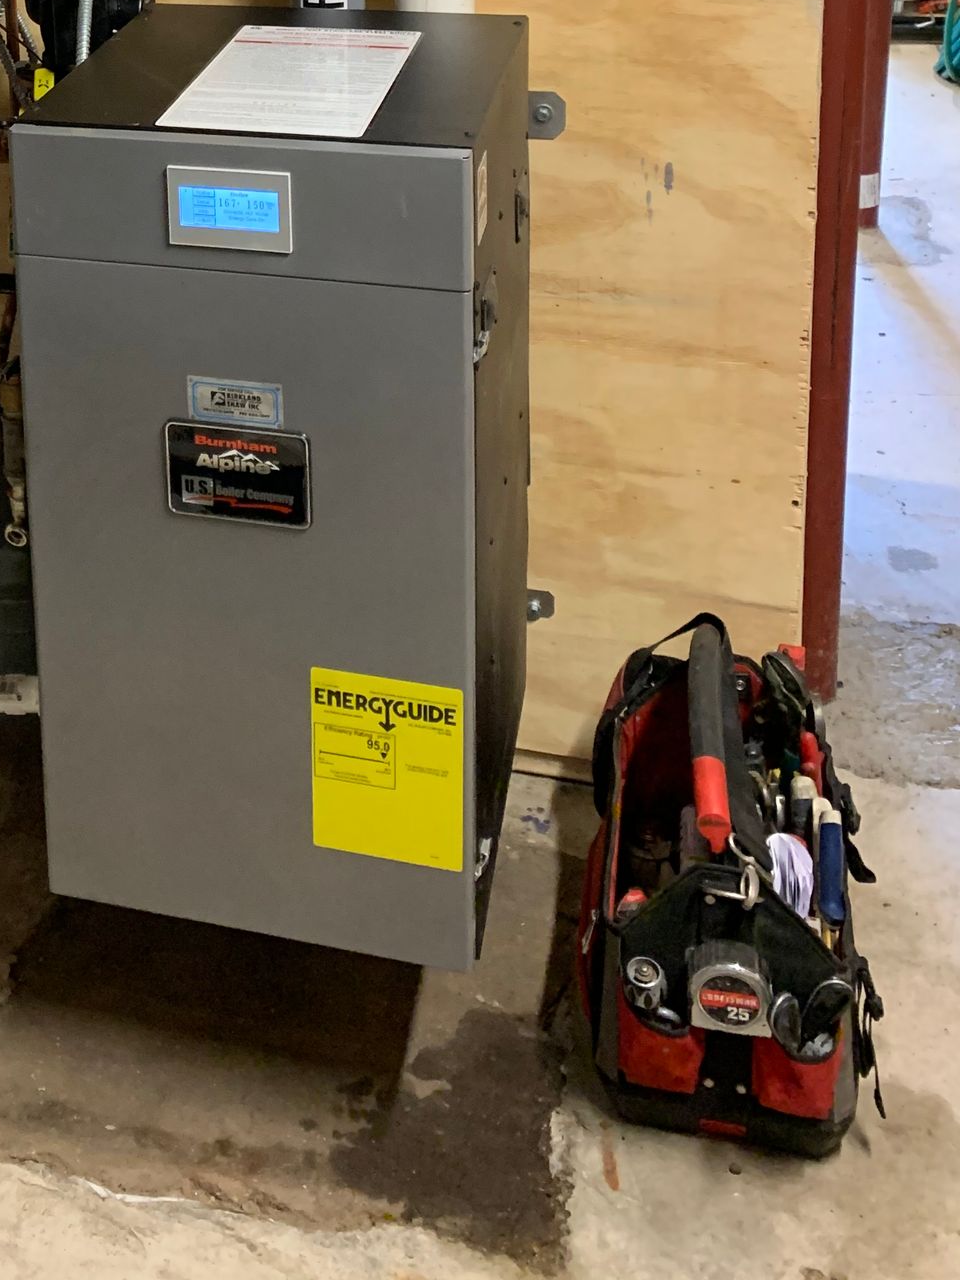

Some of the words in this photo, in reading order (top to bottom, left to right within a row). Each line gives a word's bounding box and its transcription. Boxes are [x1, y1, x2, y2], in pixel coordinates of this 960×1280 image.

[193, 433, 278, 455] Burnham
[195, 452, 272, 475] Alpine
[184, 479, 212, 496] U.S.
[215, 481, 244, 498] Boiler
[246, 487, 295, 506] Company
[314, 687, 457, 727] ENERGYGUIDE
[366, 738, 391, 753] 95.0
[727, 1006, 749, 1021] 25
